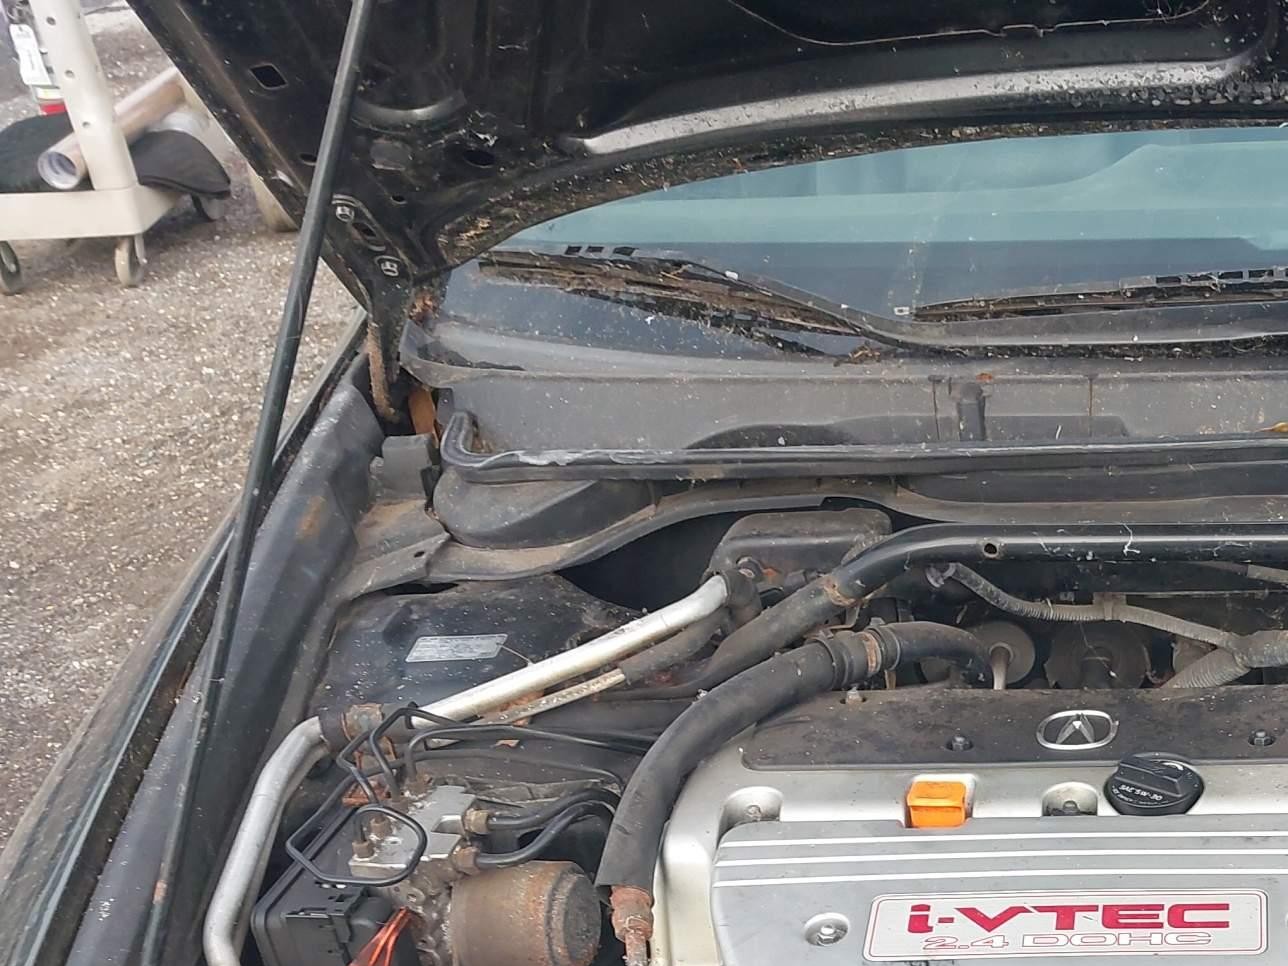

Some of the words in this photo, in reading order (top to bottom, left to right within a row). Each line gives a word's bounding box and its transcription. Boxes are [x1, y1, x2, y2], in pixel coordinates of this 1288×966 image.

[907, 903, 1230, 934] i-VTEC
[922, 934, 1010, 951] 2.4
[1021, 931, 1212, 948] DOHC
